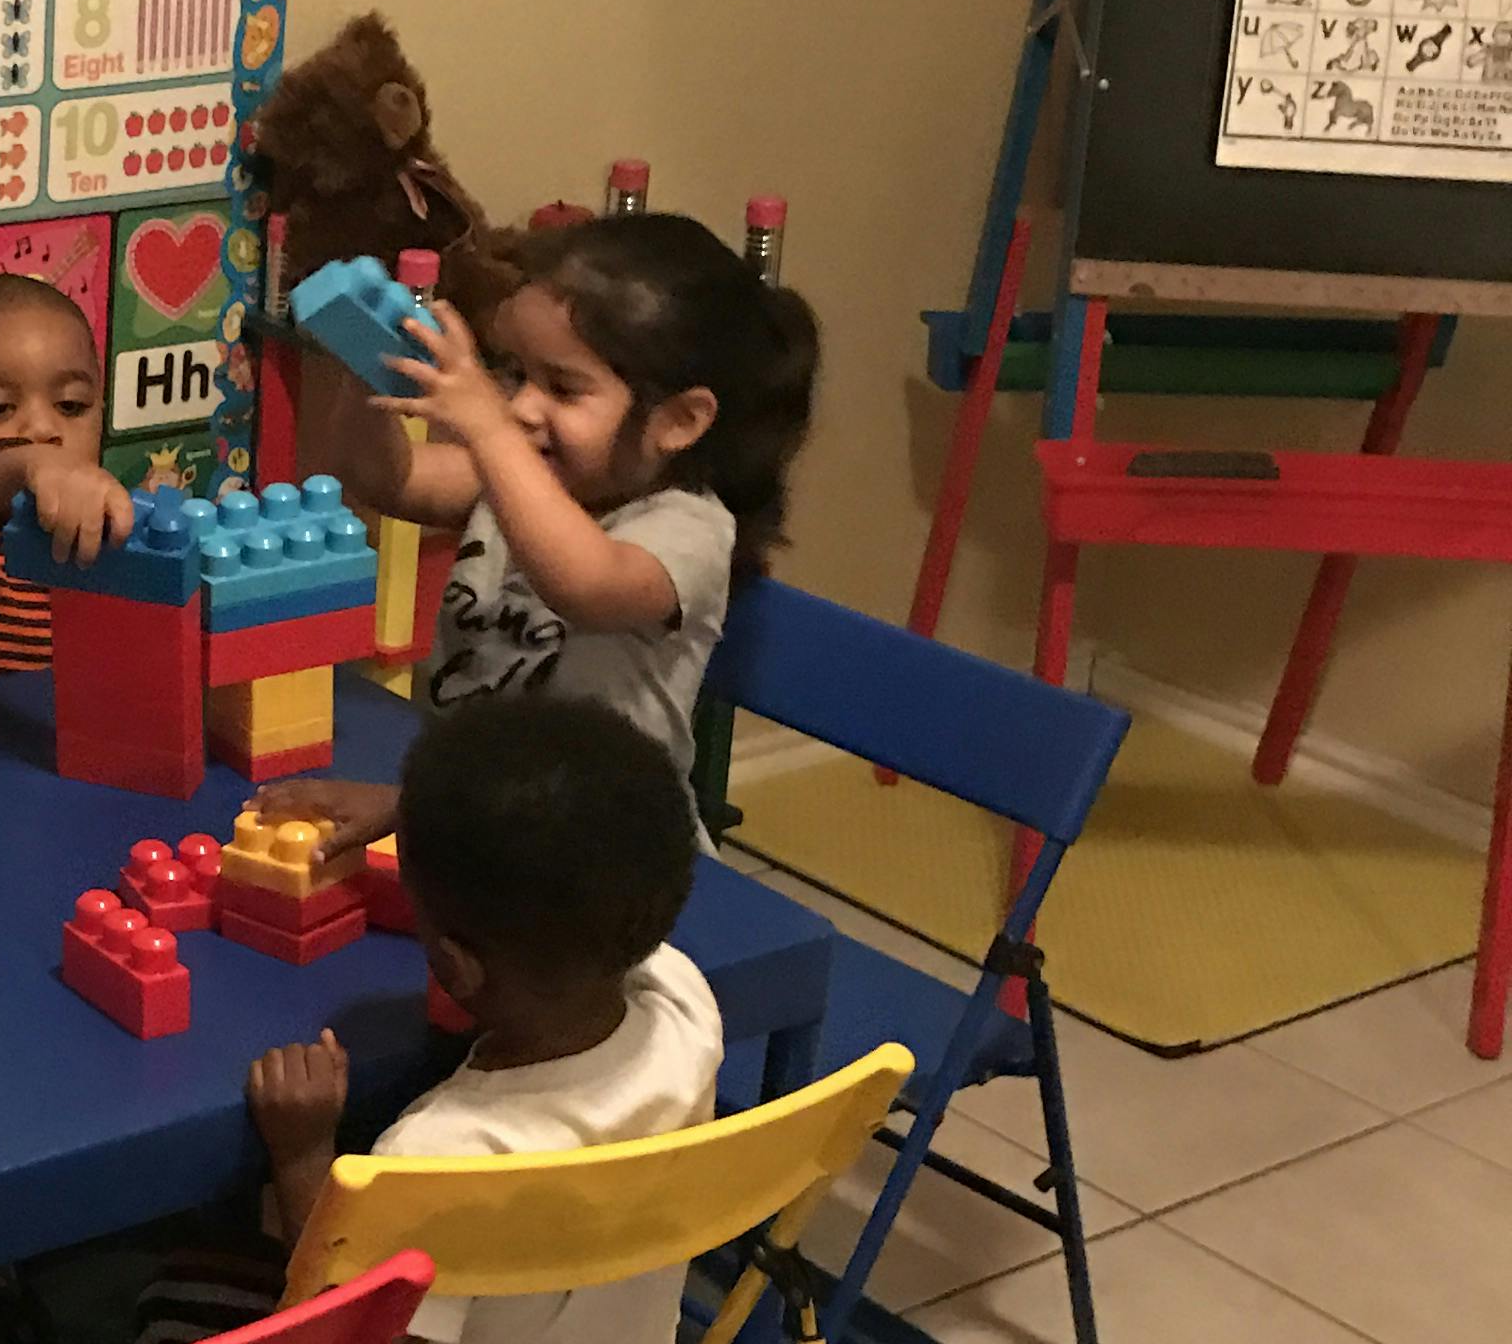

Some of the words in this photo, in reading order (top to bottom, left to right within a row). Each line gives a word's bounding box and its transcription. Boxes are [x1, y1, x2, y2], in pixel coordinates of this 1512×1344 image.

[1243, 15, 1260, 36] u
[1320, 18, 1338, 39] v
[1396, 23, 1418, 43] w
[1468, 25, 1486, 46] x
[64, 54, 125, 84] Eight
[1237, 75, 1253, 105] y
[1311, 80, 1329, 100] z
[56, 101, 119, 162] 10
[67, 171, 107, 194] Ten
[135, 349, 209, 409] Hh
